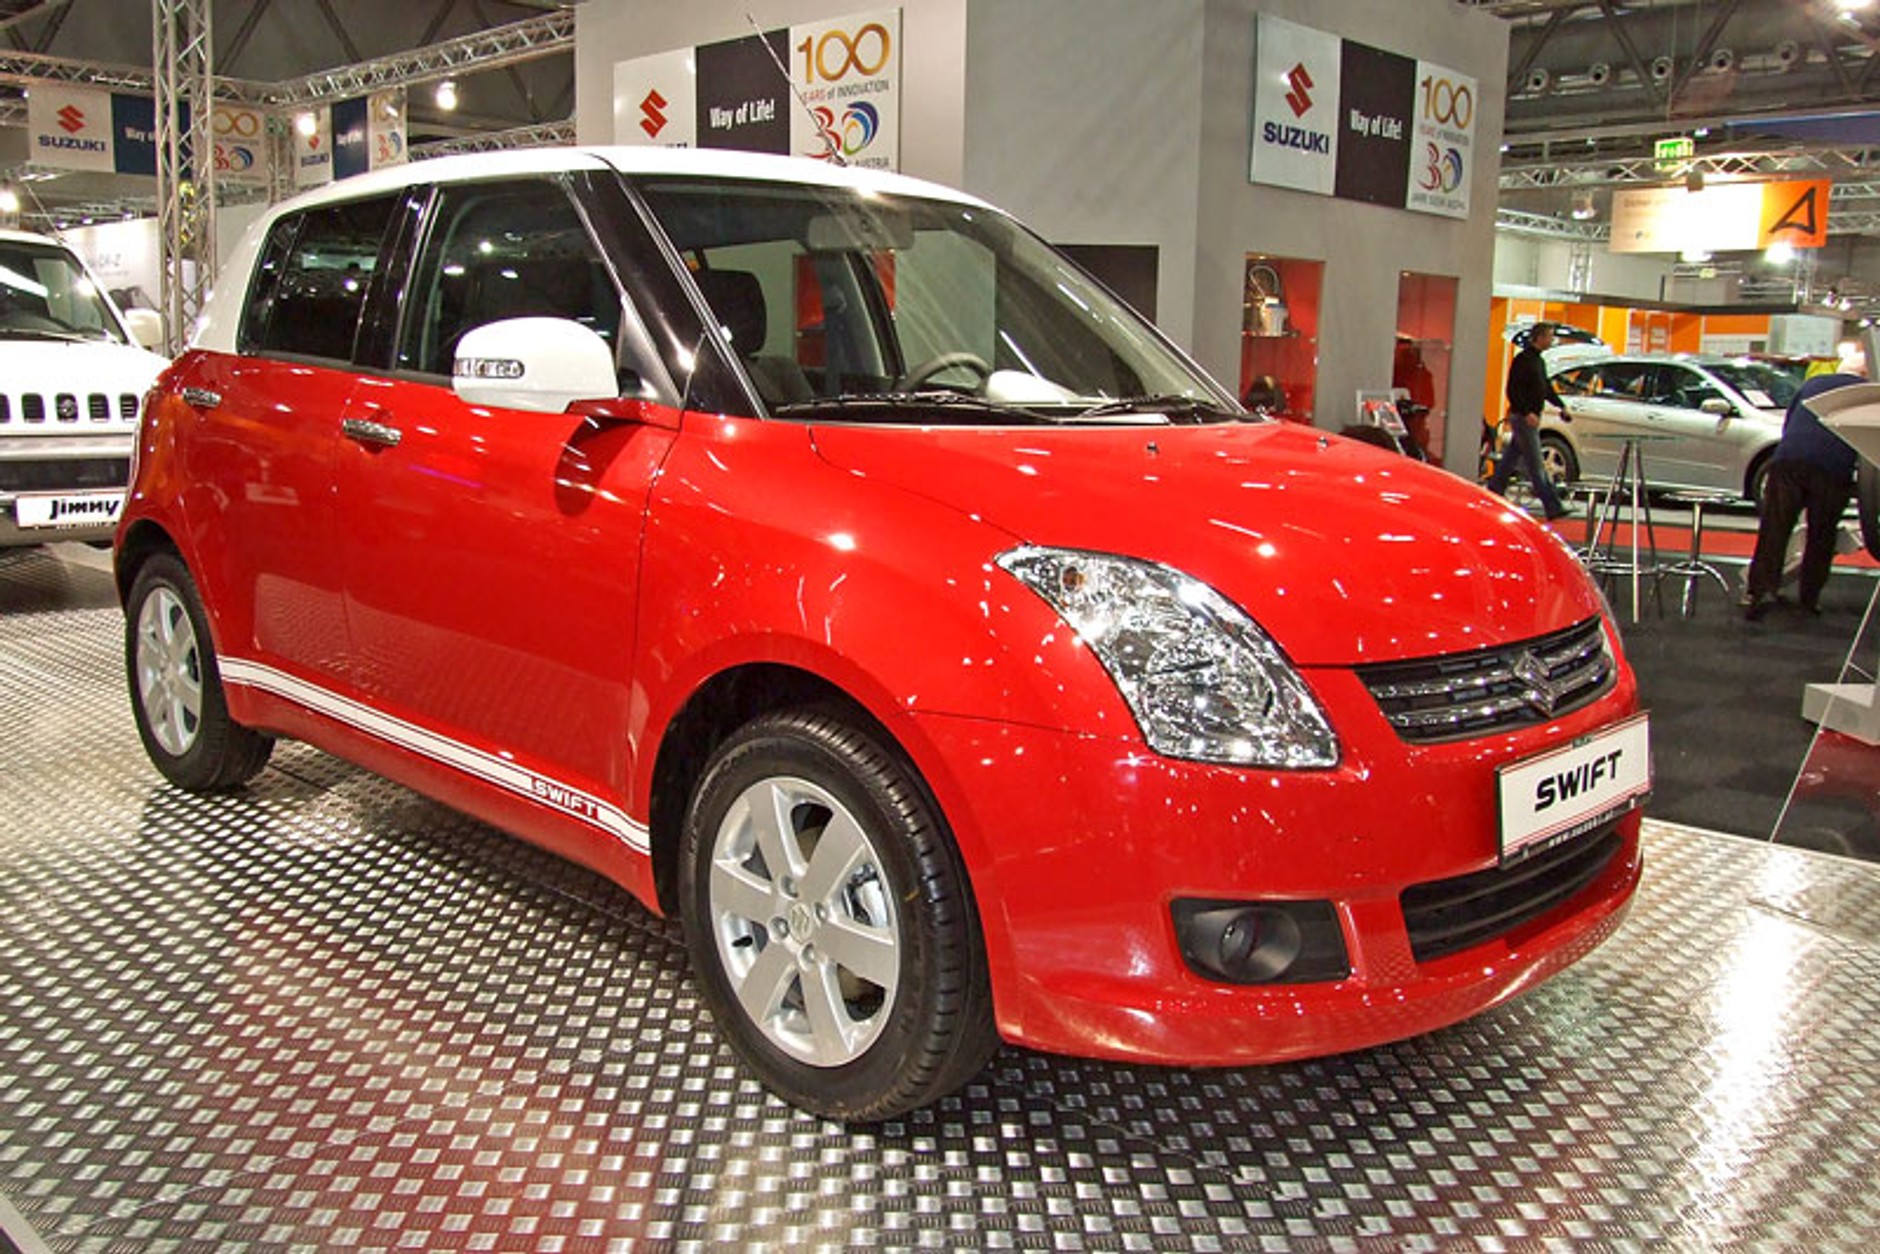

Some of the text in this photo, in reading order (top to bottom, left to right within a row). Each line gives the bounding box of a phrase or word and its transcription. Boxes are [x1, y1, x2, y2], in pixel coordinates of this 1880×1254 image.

[797, 23, 891, 84] 100
[709, 98, 775, 131] Way of Life!
[1421, 75, 1473, 130] 100
[1263, 122, 1330, 154] SUZUKI
[1350, 109, 1371, 137] Way
[1371, 115, 1382, 136] of
[1382, 114, 1403, 140] Life!
[38, 134, 107, 152] SUZUKI
[49, 499, 119, 520] Jimny
[1534, 749, 1623, 812] SWIFT
[534, 779, 597, 817] SWIFT
